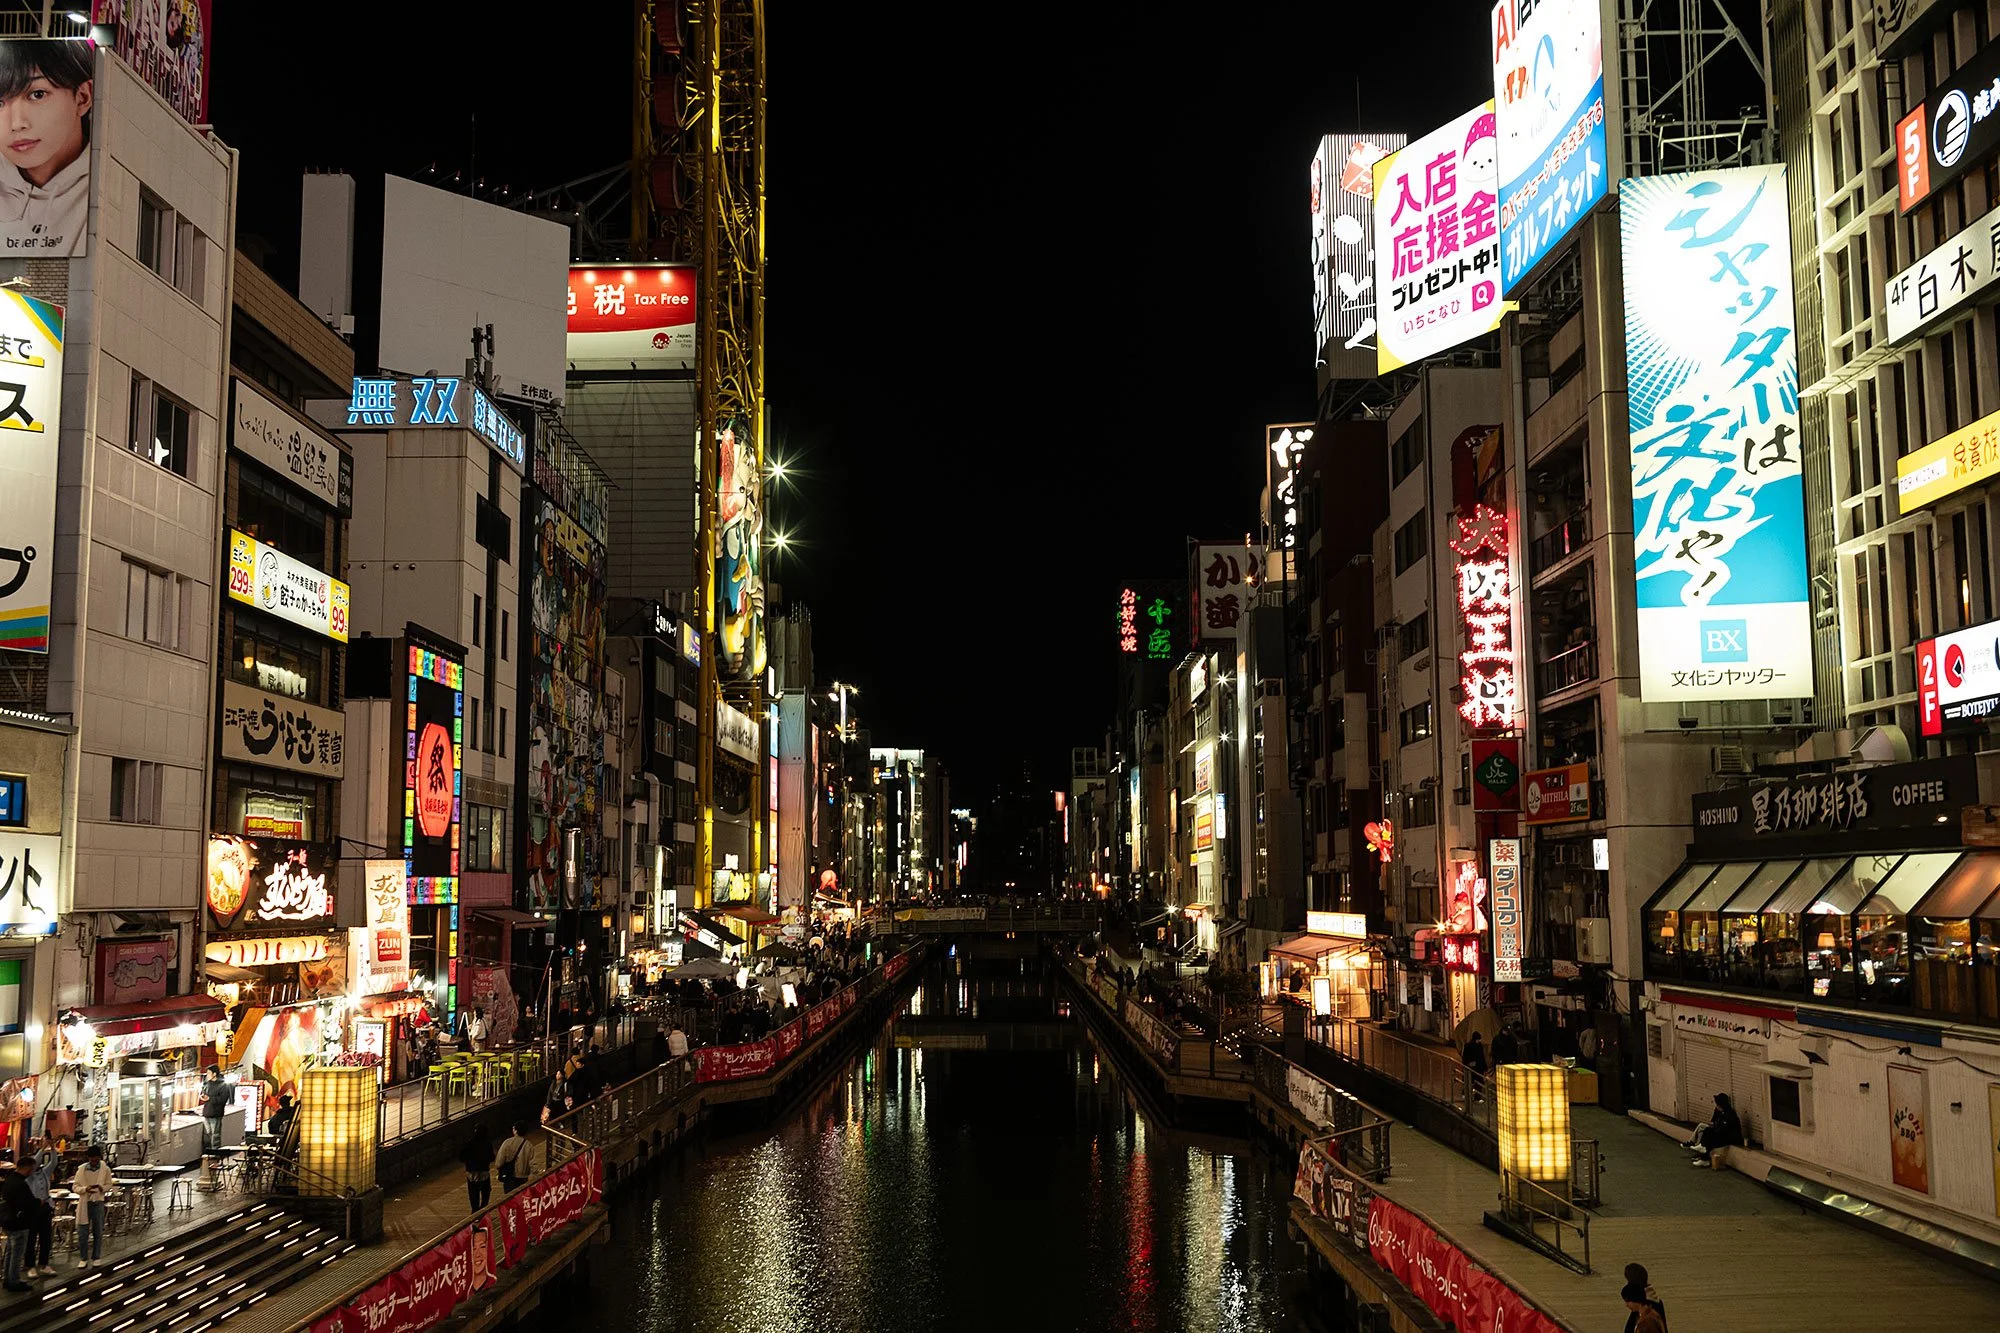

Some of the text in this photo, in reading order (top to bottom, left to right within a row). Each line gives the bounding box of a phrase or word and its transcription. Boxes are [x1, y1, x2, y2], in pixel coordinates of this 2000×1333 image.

[1391, 150, 1457, 226] 入店
[1904, 119, 1920, 197] 5F
[1392, 190, 1496, 281] 応援金
[1506, 145, 1601, 282] ガルフネット
[634, 293, 657, 305] Tax
[661, 293, 689, 305] Free
[1891, 275, 1909, 306] 4F
[1120, 588, 1137, 651] お好み焼
[1450, 503, 1516, 728] 大阪王将
[1706, 630, 1743, 652] BX
[1922, 654, 1937, 723] 2F
[1541, 791, 1569, 804] MITHILA
[1700, 774, 1944, 834] HOSHINO 星乃珈琲店 COFFEE
[1496, 841, 1515, 862] 薬
[1496, 867, 1517, 927] ダイコク
[379, 938, 401, 950] ZUN
[1900, 1127, 1916, 1142] BBQ
